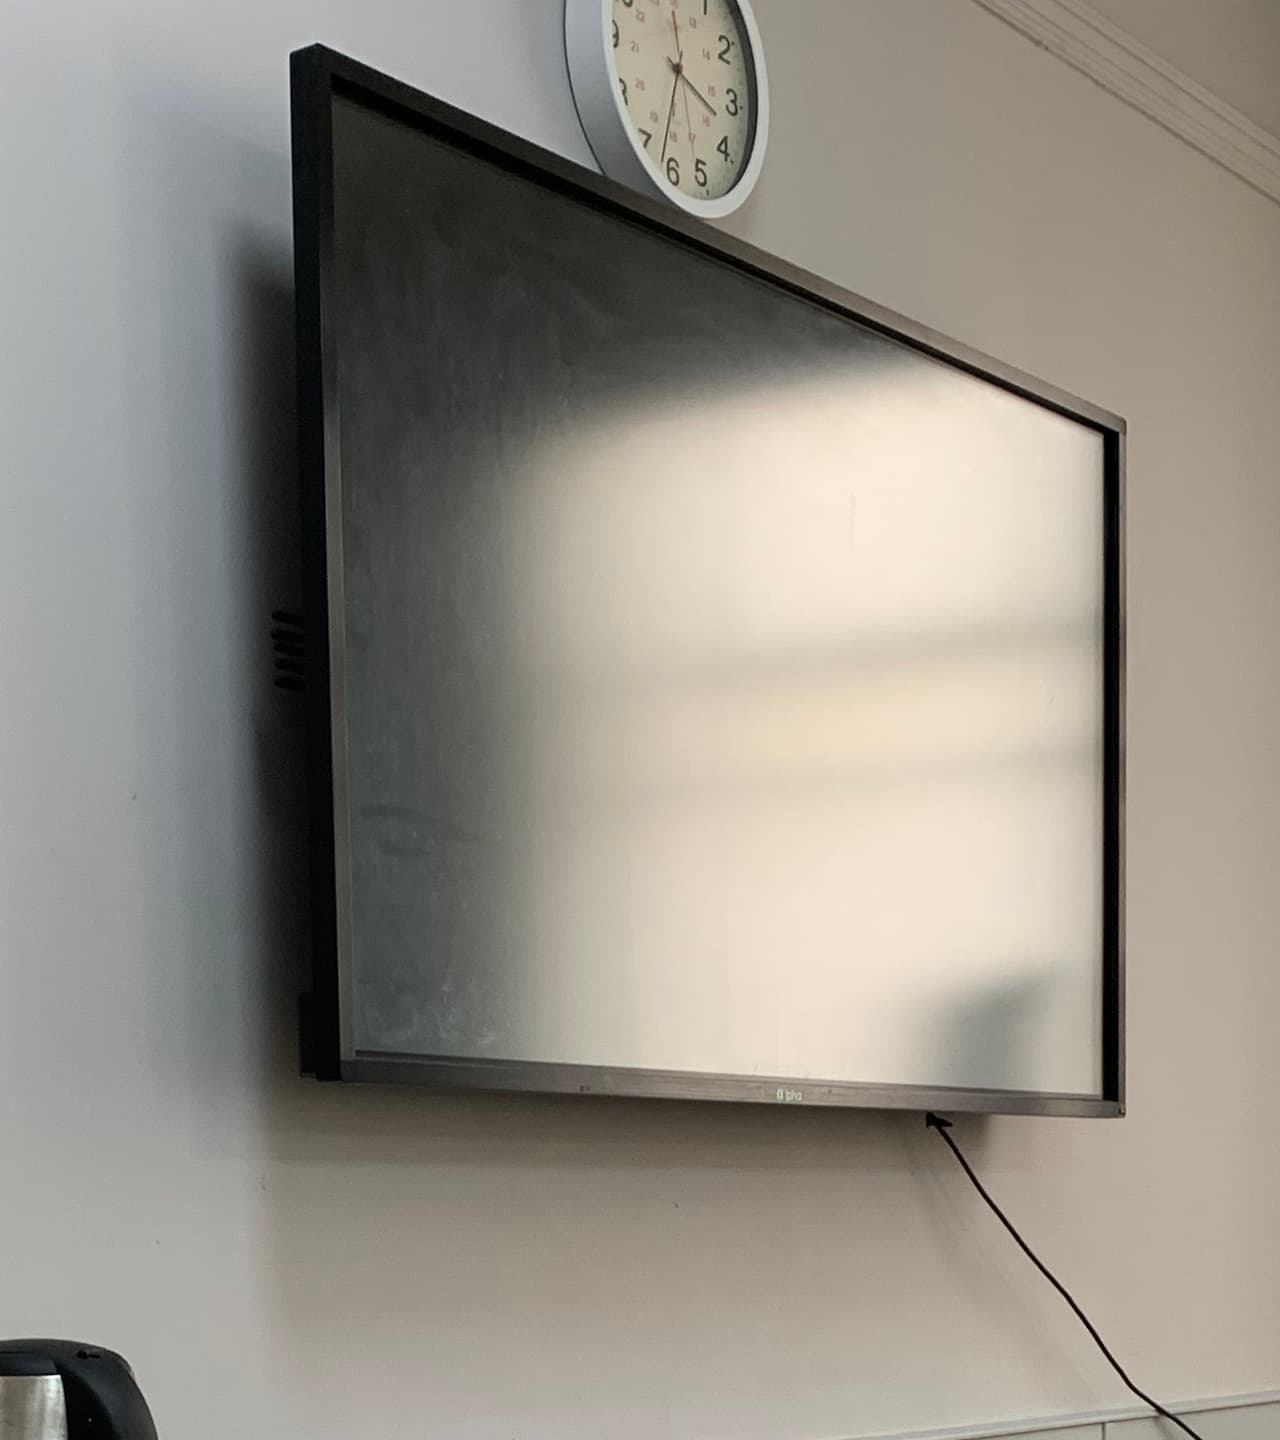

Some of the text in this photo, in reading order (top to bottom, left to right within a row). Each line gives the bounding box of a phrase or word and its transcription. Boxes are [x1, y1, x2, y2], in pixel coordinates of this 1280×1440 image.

[718, 34, 731, 65] 2
[725, 88, 738, 117] 3
[638, 127, 652, 149] 7
[716, 135, 730, 162] 4
[666, 156, 680, 187] 6
[694, 158, 707, 187] 5
